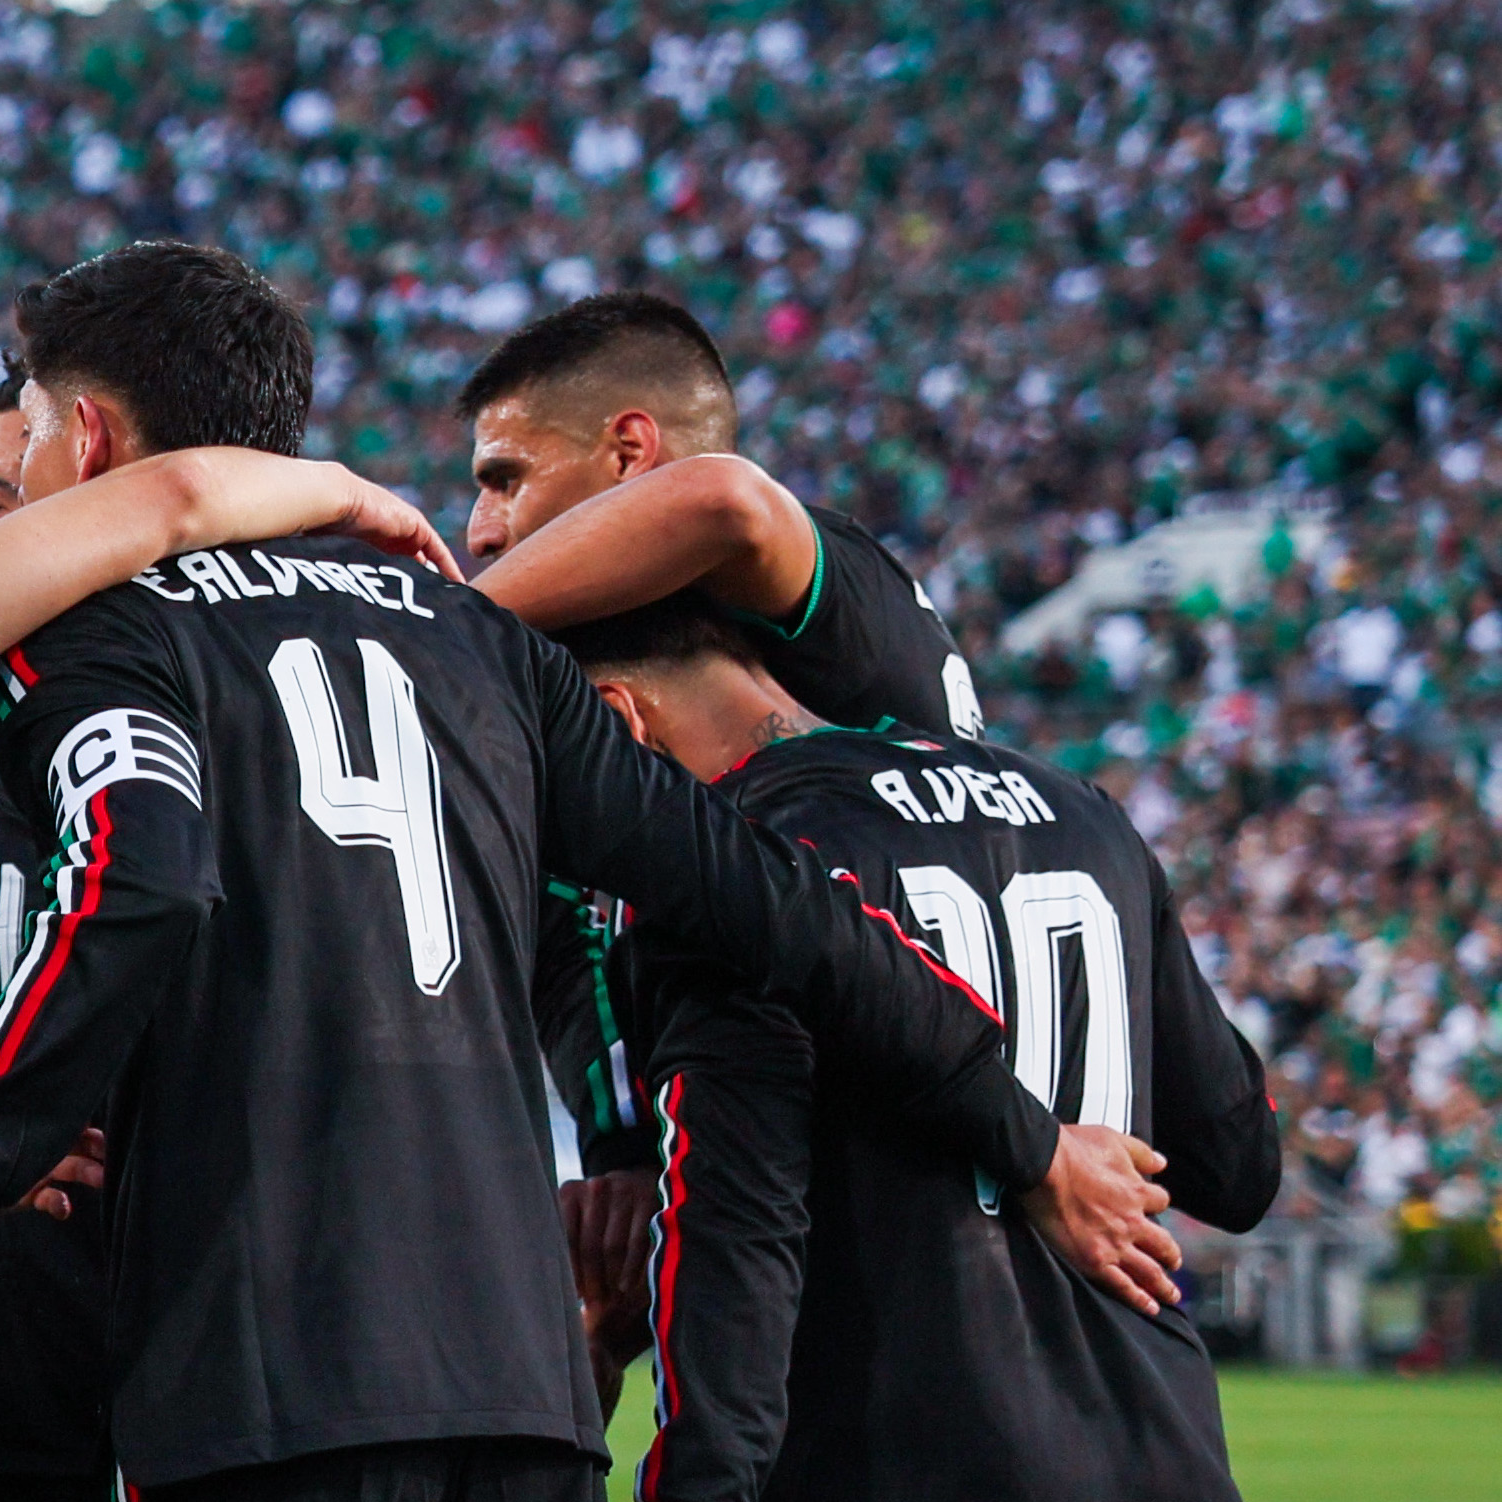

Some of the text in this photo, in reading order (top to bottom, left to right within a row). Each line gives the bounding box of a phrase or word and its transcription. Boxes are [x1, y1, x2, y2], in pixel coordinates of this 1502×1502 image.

[67, 728, 117, 789] C
[267, 637, 462, 997] 4
[870, 765, 1057, 826] A.VEGA
